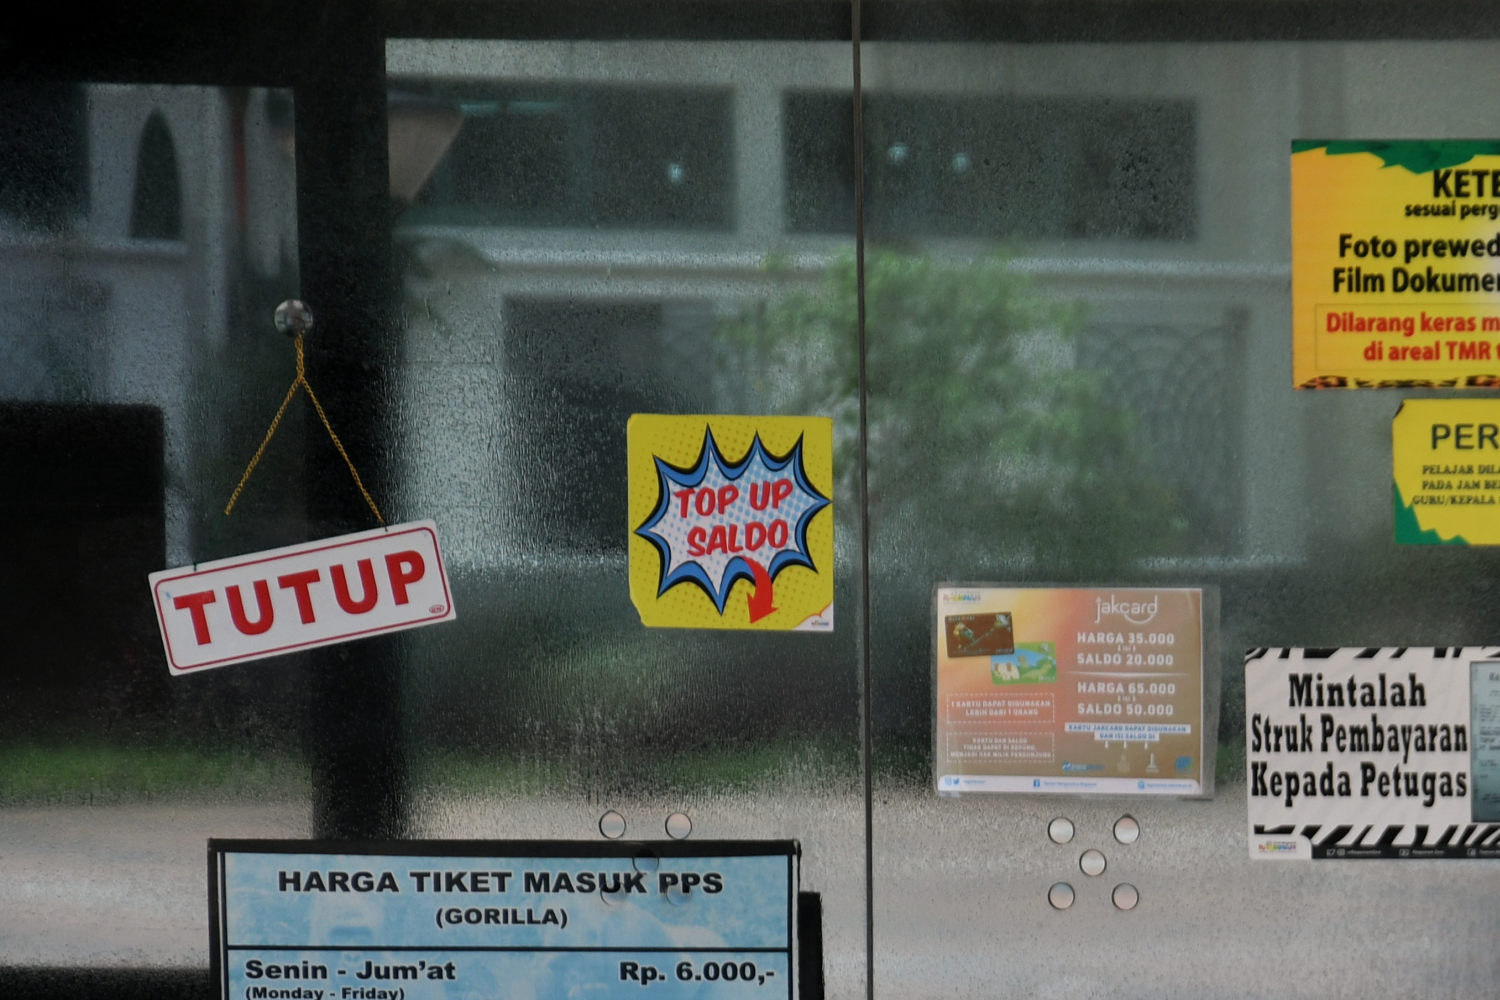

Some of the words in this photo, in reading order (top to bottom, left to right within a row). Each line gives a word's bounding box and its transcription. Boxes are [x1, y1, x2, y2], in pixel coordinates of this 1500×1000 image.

[1404, 200, 1455, 217] sesuai
[1339, 233, 1397, 258] Foto
[1333, 267, 1385, 292] Film
[1326, 312, 1415, 337] Dilarang
[1421, 311, 1476, 332] keras
[1363, 340, 1383, 361] di
[1388, 341, 1440, 360] areal
[1446, 341, 1491, 360] TMR
[1422, 465, 1474, 475] PELAJAR
[1422, 480, 1453, 490] PADA
[1457, 480, 1480, 490] JAM
[673, 483, 739, 518] TOP
[749, 478, 793, 511] UP
[686, 518, 789, 557] SALDO
[172, 549, 427, 647] TUTUP
[1094, 594, 1158, 624] jakcard
[1077, 632, 1124, 644] HARGA
[1128, 632, 1175, 645] 35.000
[1077, 653, 1122, 665] SALDO
[1126, 654, 1174, 666] 20.000
[1077, 682, 1124, 694] HARGA
[1128, 683, 1176, 694] 65.000
[1288, 672, 1427, 707] Mintalah
[1077, 703, 1122, 715] SALDO
[1126, 704, 1174, 716] 50.000
[1251, 713, 1313, 752] Struk
[1320, 713, 1468, 764] Pembayaran
[1251, 761, 1351, 808] Kepada
[1360, 761, 1467, 808] Petugas
[278, 871, 399, 892] HARGA
[409, 871, 512, 893] TIKET
[524, 872, 647, 893] MASUK
[659, 872, 723, 893] PPS
[435, 907, 568, 929] (GORILLA)
[245, 959, 328, 980] Senin
[355, 960, 456, 980] Jum'at
[620, 962, 665, 985] Rp.
[676, 961, 775, 985] 6.000,-
